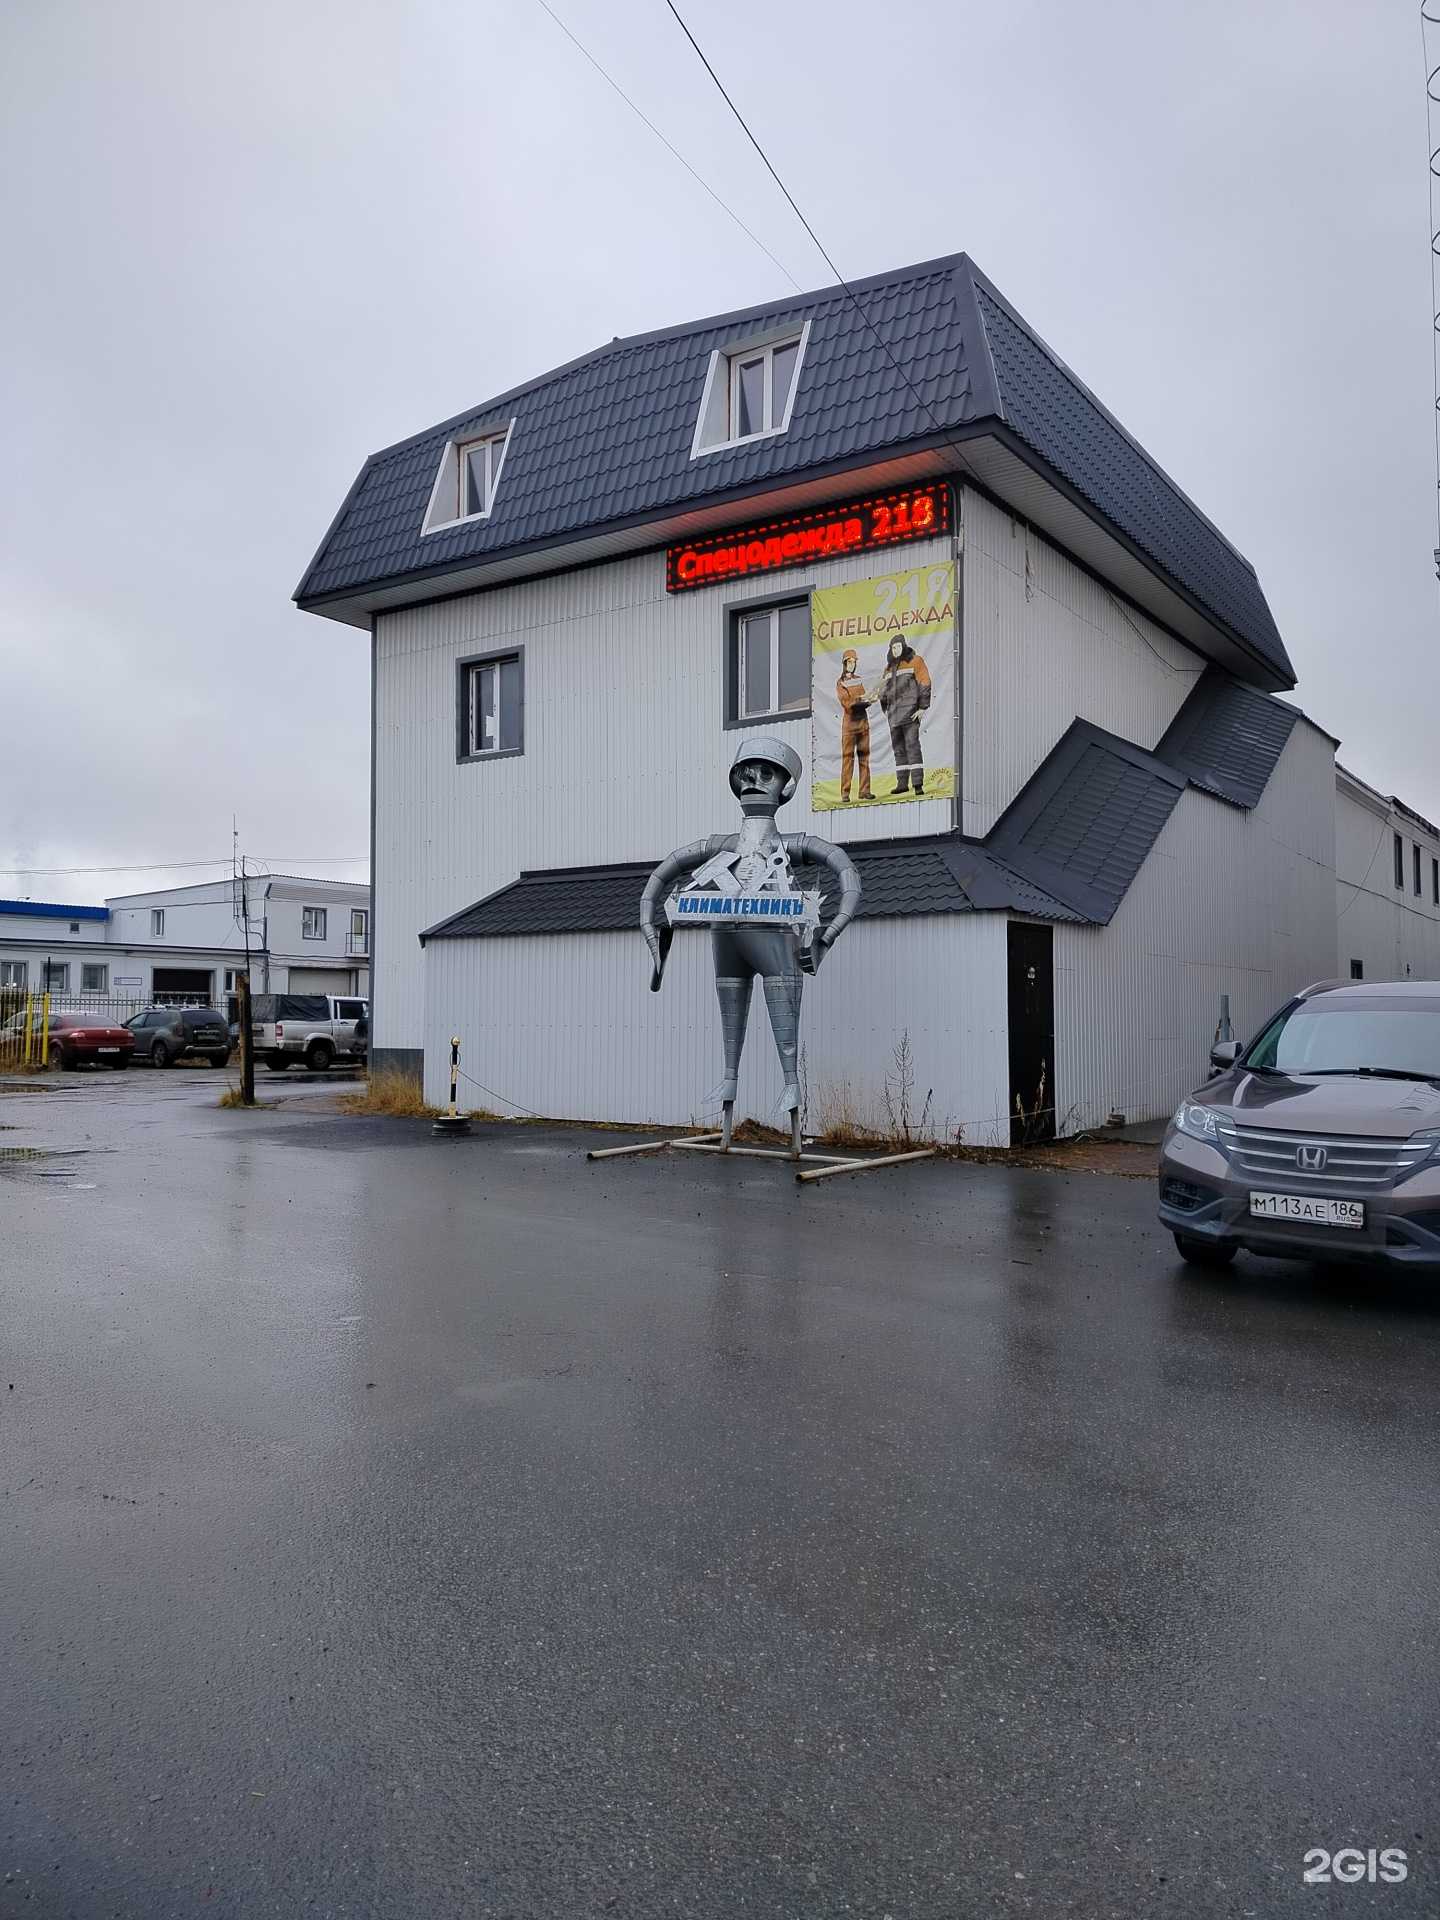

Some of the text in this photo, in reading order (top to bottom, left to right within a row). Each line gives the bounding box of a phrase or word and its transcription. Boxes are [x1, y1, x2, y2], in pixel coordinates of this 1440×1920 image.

[677, 517, 863, 580] Спецодежда
[816, 602, 954, 641] СПЕЦОДЕЖДА
[1330, 1202, 1358, 1217] 186
